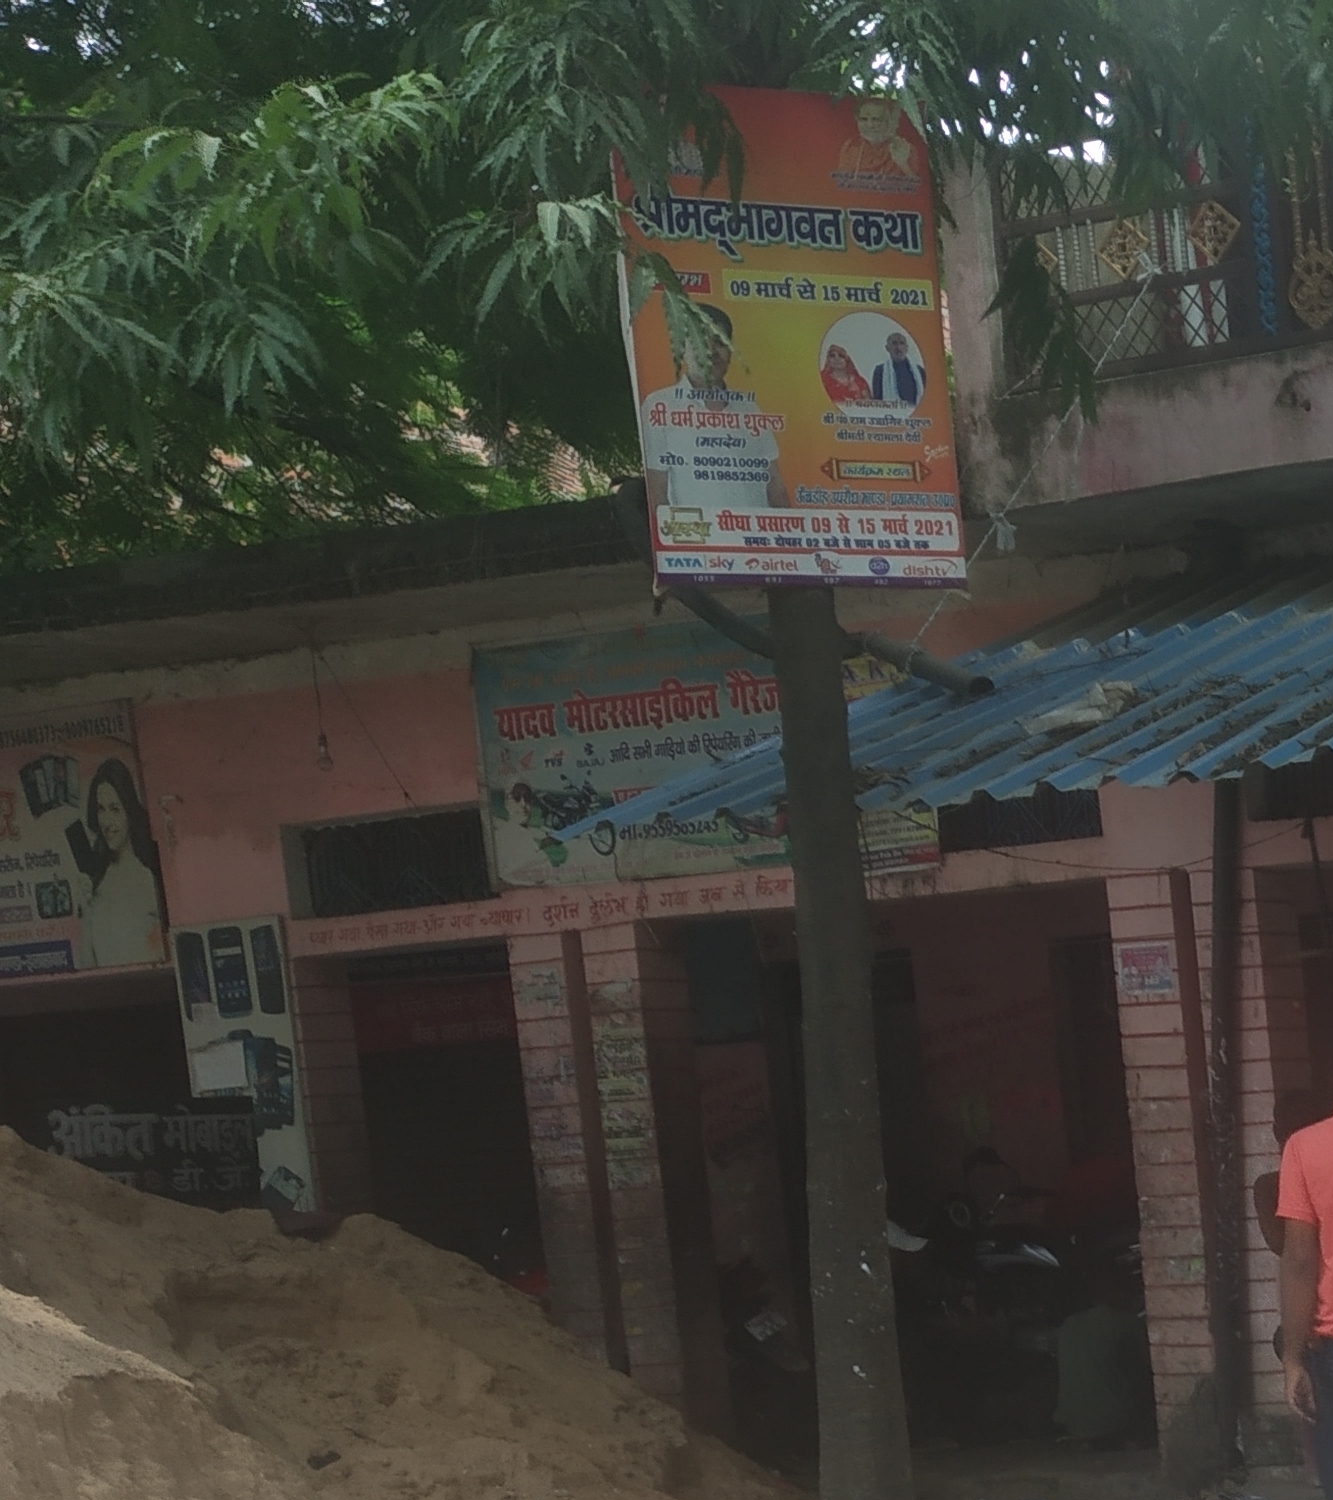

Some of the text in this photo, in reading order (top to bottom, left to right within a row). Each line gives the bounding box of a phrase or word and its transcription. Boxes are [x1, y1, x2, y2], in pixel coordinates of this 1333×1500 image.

[848, 209, 920, 250] कथा
[730, 279, 751, 298] 09
[755, 277, 794, 300] मार्च
[796, 278, 816, 301] से
[822, 285, 841, 302] 15
[845, 281, 883, 304] मार्च
[890, 289, 928, 306] 2021
[650, 402, 785, 437] श्री धर्म प्रकाश शुक्ल
[715, 510, 954, 537] सीधा प्रसारण 09 से 15 मार्च 2021
[665, 557, 703, 569] TATA
[708, 554, 735, 572] sky
[761, 558, 799, 572] airtel
[495, 703, 557, 741] यादव
[562, 677, 719, 733] मोटरसाइकिल
[609, 746, 631, 765] आदि
[632, 742, 654, 762] सभी
[687, 734, 701, 755] की
